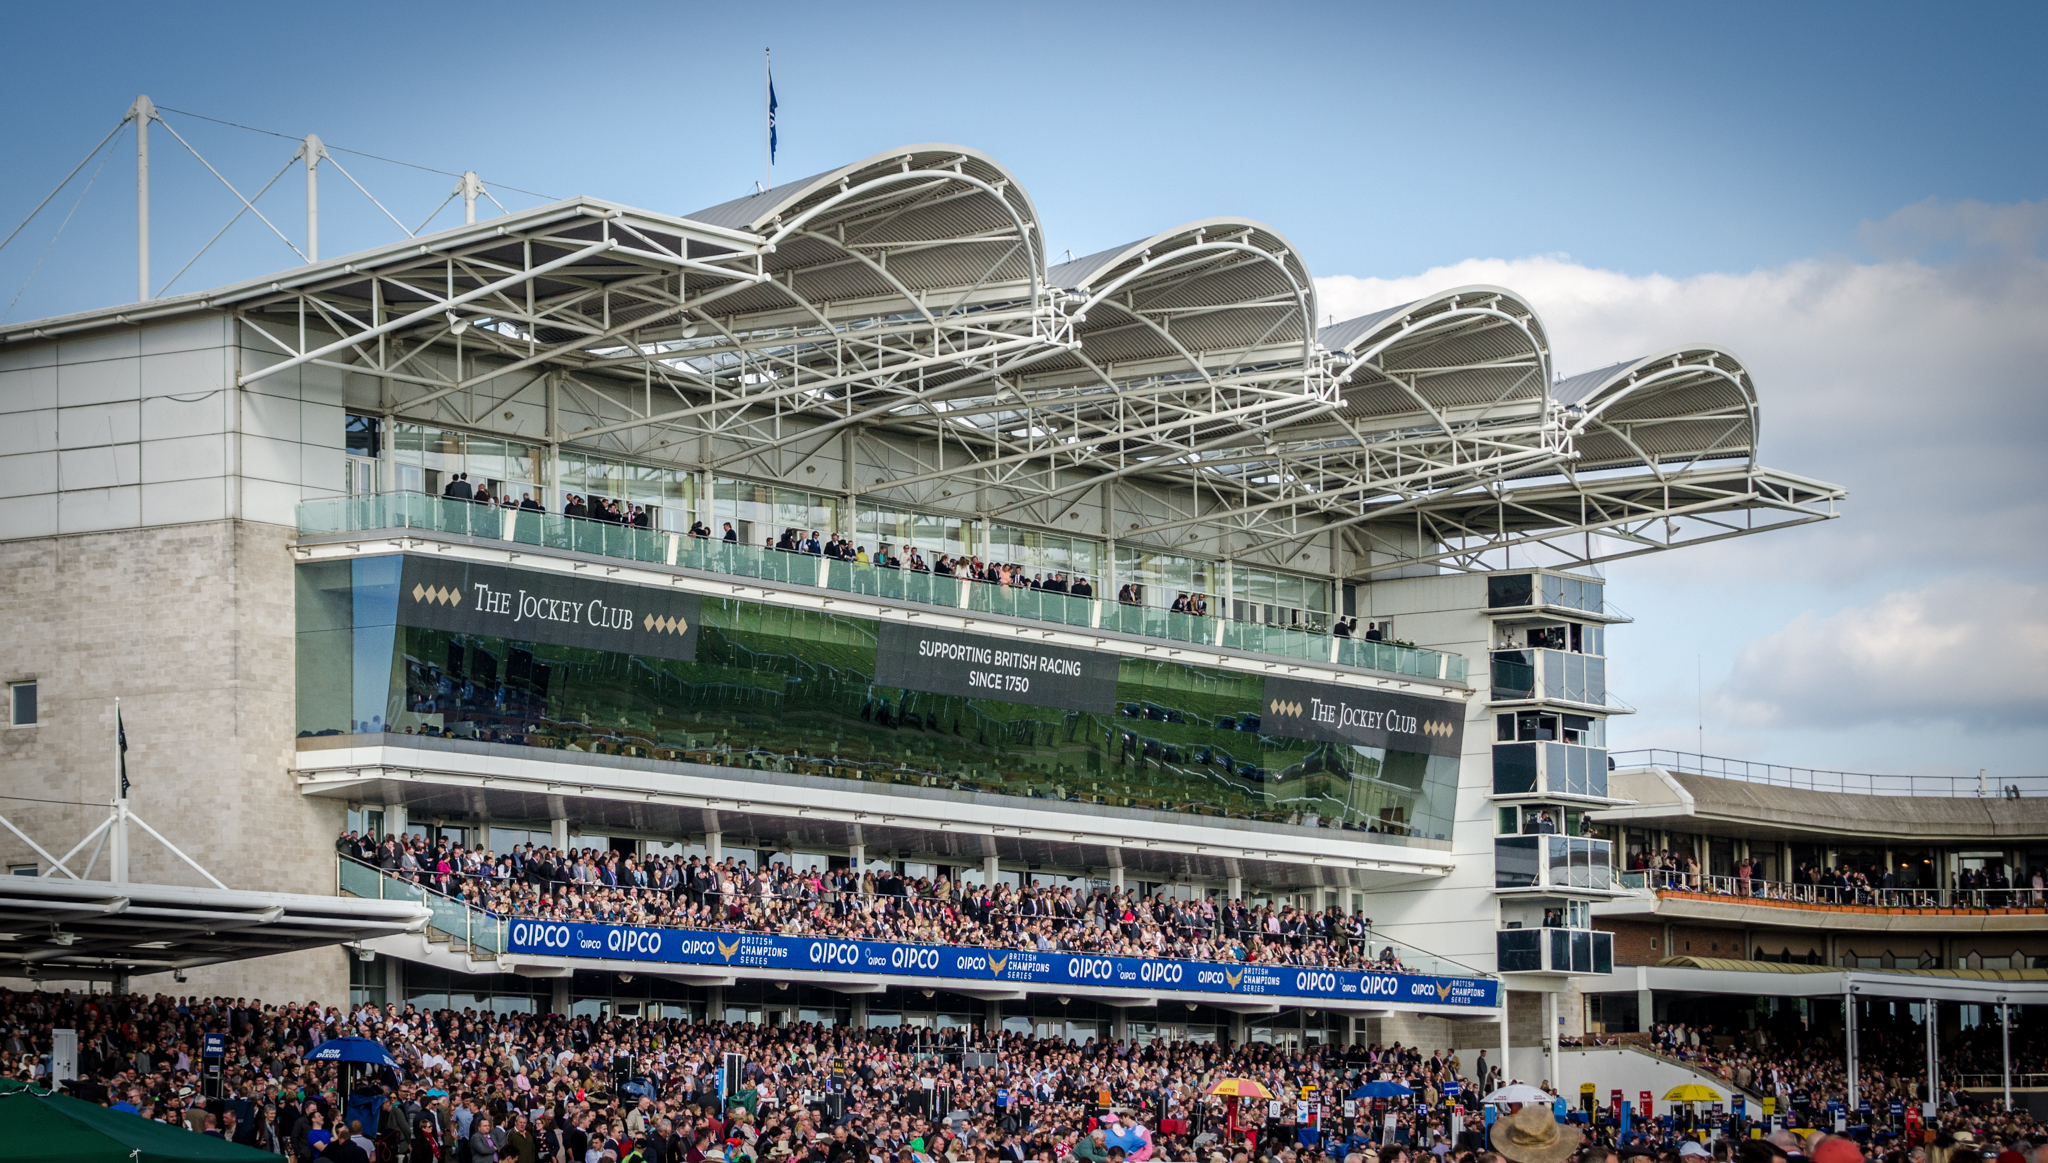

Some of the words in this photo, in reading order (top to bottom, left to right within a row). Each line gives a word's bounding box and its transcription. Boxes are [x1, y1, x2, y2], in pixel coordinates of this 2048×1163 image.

[919, 640, 992, 664] SUPPORTING
[994, 651, 1037, 671] BRITISH
[1039, 657, 1081, 677] RACING
[969, 671, 1002, 690] SINCE
[1005, 676, 1029, 693] 1750
[513, 923, 570, 948] QIPCO
[608, 929, 662, 954] QIPCO
[741, 936, 773, 946] BRITISH
[580, 939, 601, 950] QIPCO
[682, 940, 715, 955] QIPCO
[741, 945, 788, 958] CHAMPIONS
[809, 941, 859, 965] QIPCO
[1008, 952, 1037, 962] BRITISH
[740, 956, 768, 966] SERIES
[868, 956, 887, 966] QIPCO
[891, 946, 939, 970] QIPCO
[957, 956, 986, 971] QIPCO
[1008, 961, 1050, 973] CHAMPIONS
[1068, 958, 1112, 980] QIPCO
[1141, 962, 1183, 983] QIPCO
[1243, 967, 1269, 976] BRITISH
[1007, 971, 1032, 980] SERIES
[1120, 971, 1136, 981] QIPCO
[1198, 970, 1224, 984] QIPCO
[1243, 975, 1280, 986] CHAMPIONS
[1296, 971, 1336, 992] QIPCO
[1242, 984, 1265, 992] SERIES
[1342, 984, 1357, 993] QIPCO
[1360, 975, 1398, 996] QIPCO
[1411, 983, 1435, 996] QIPCO
[1452, 980, 1474, 988] BRITISH
[1451, 987, 1485, 997] CHAMPIONS
[1451, 996, 1471, 1004] SERIES
